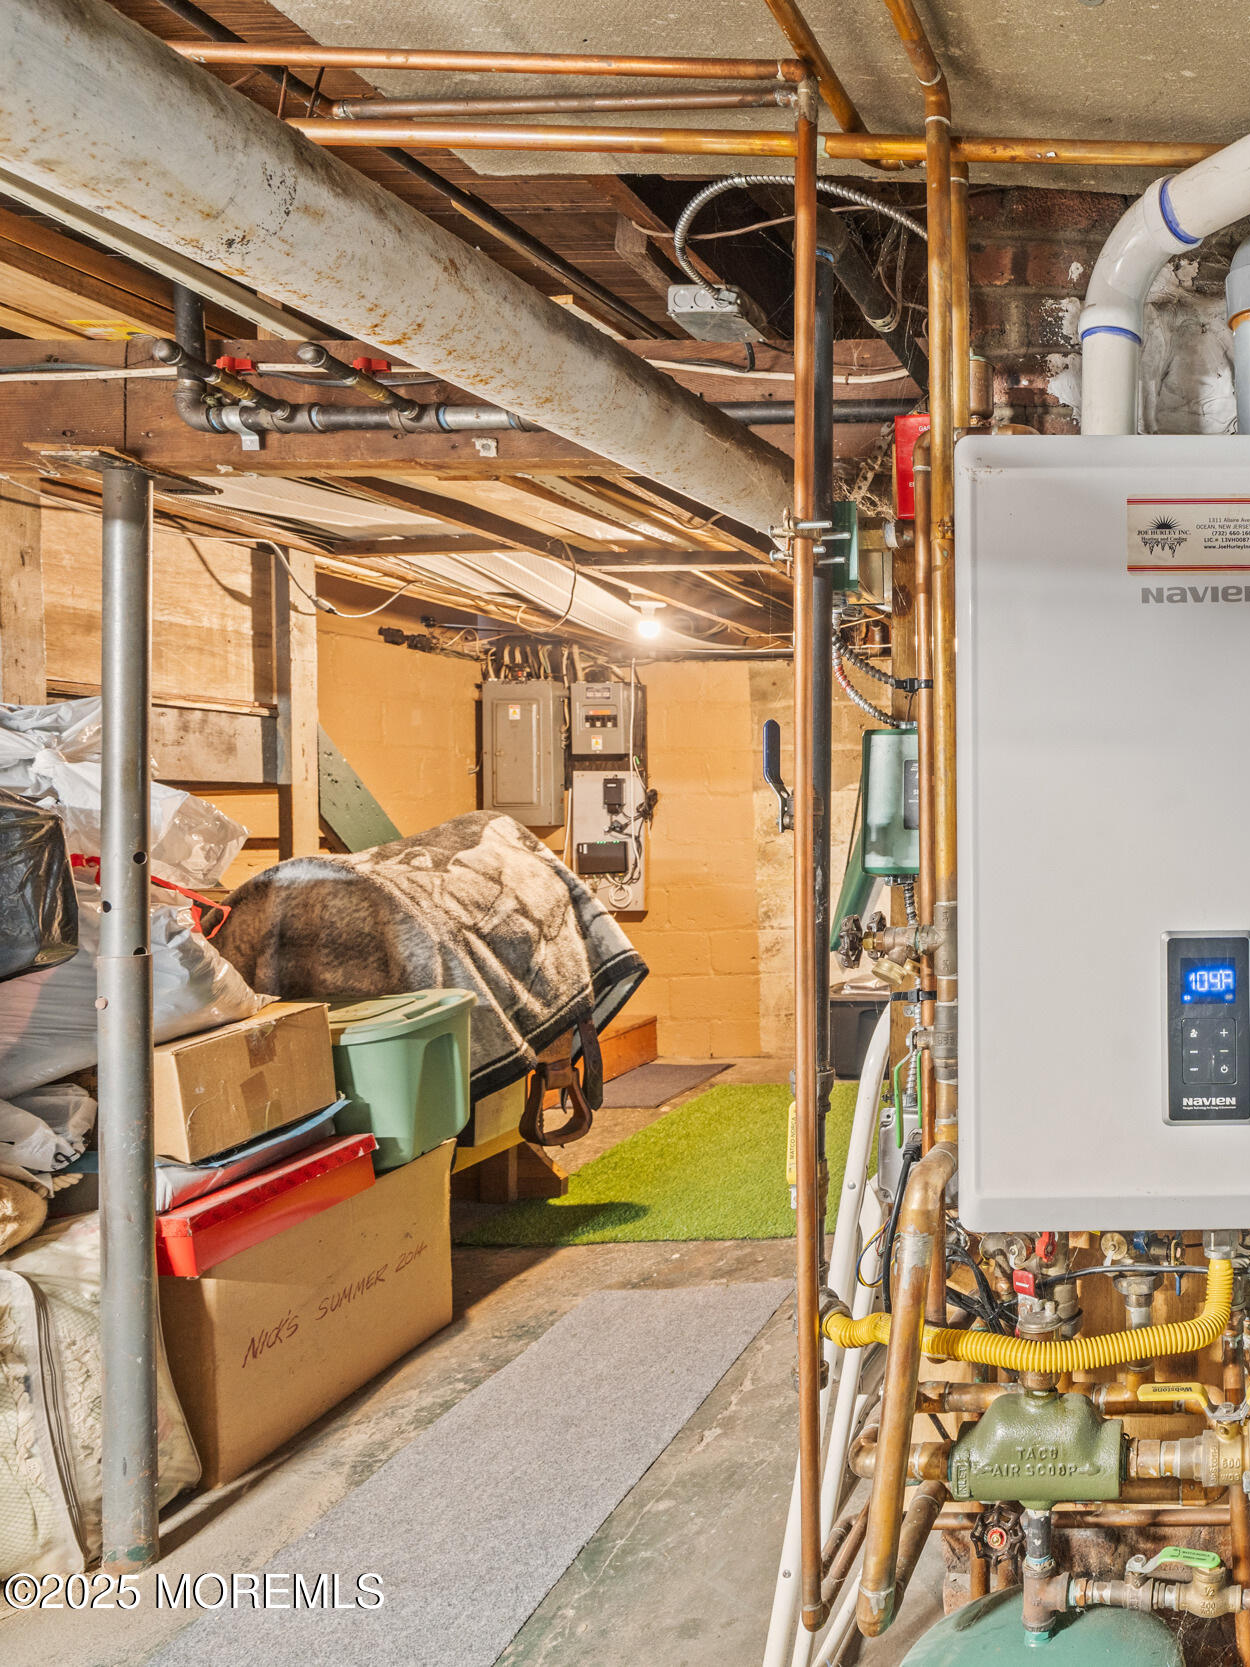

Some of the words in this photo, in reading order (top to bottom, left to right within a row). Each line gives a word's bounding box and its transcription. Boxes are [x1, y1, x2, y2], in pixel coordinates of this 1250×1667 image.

[315, 1263, 389, 1321] SUMMER
[1015, 1446, 1059, 1460] TACO
[991, 1463, 1021, 1477] AIR
[1024, 1463, 1078, 1477] SCOOP
